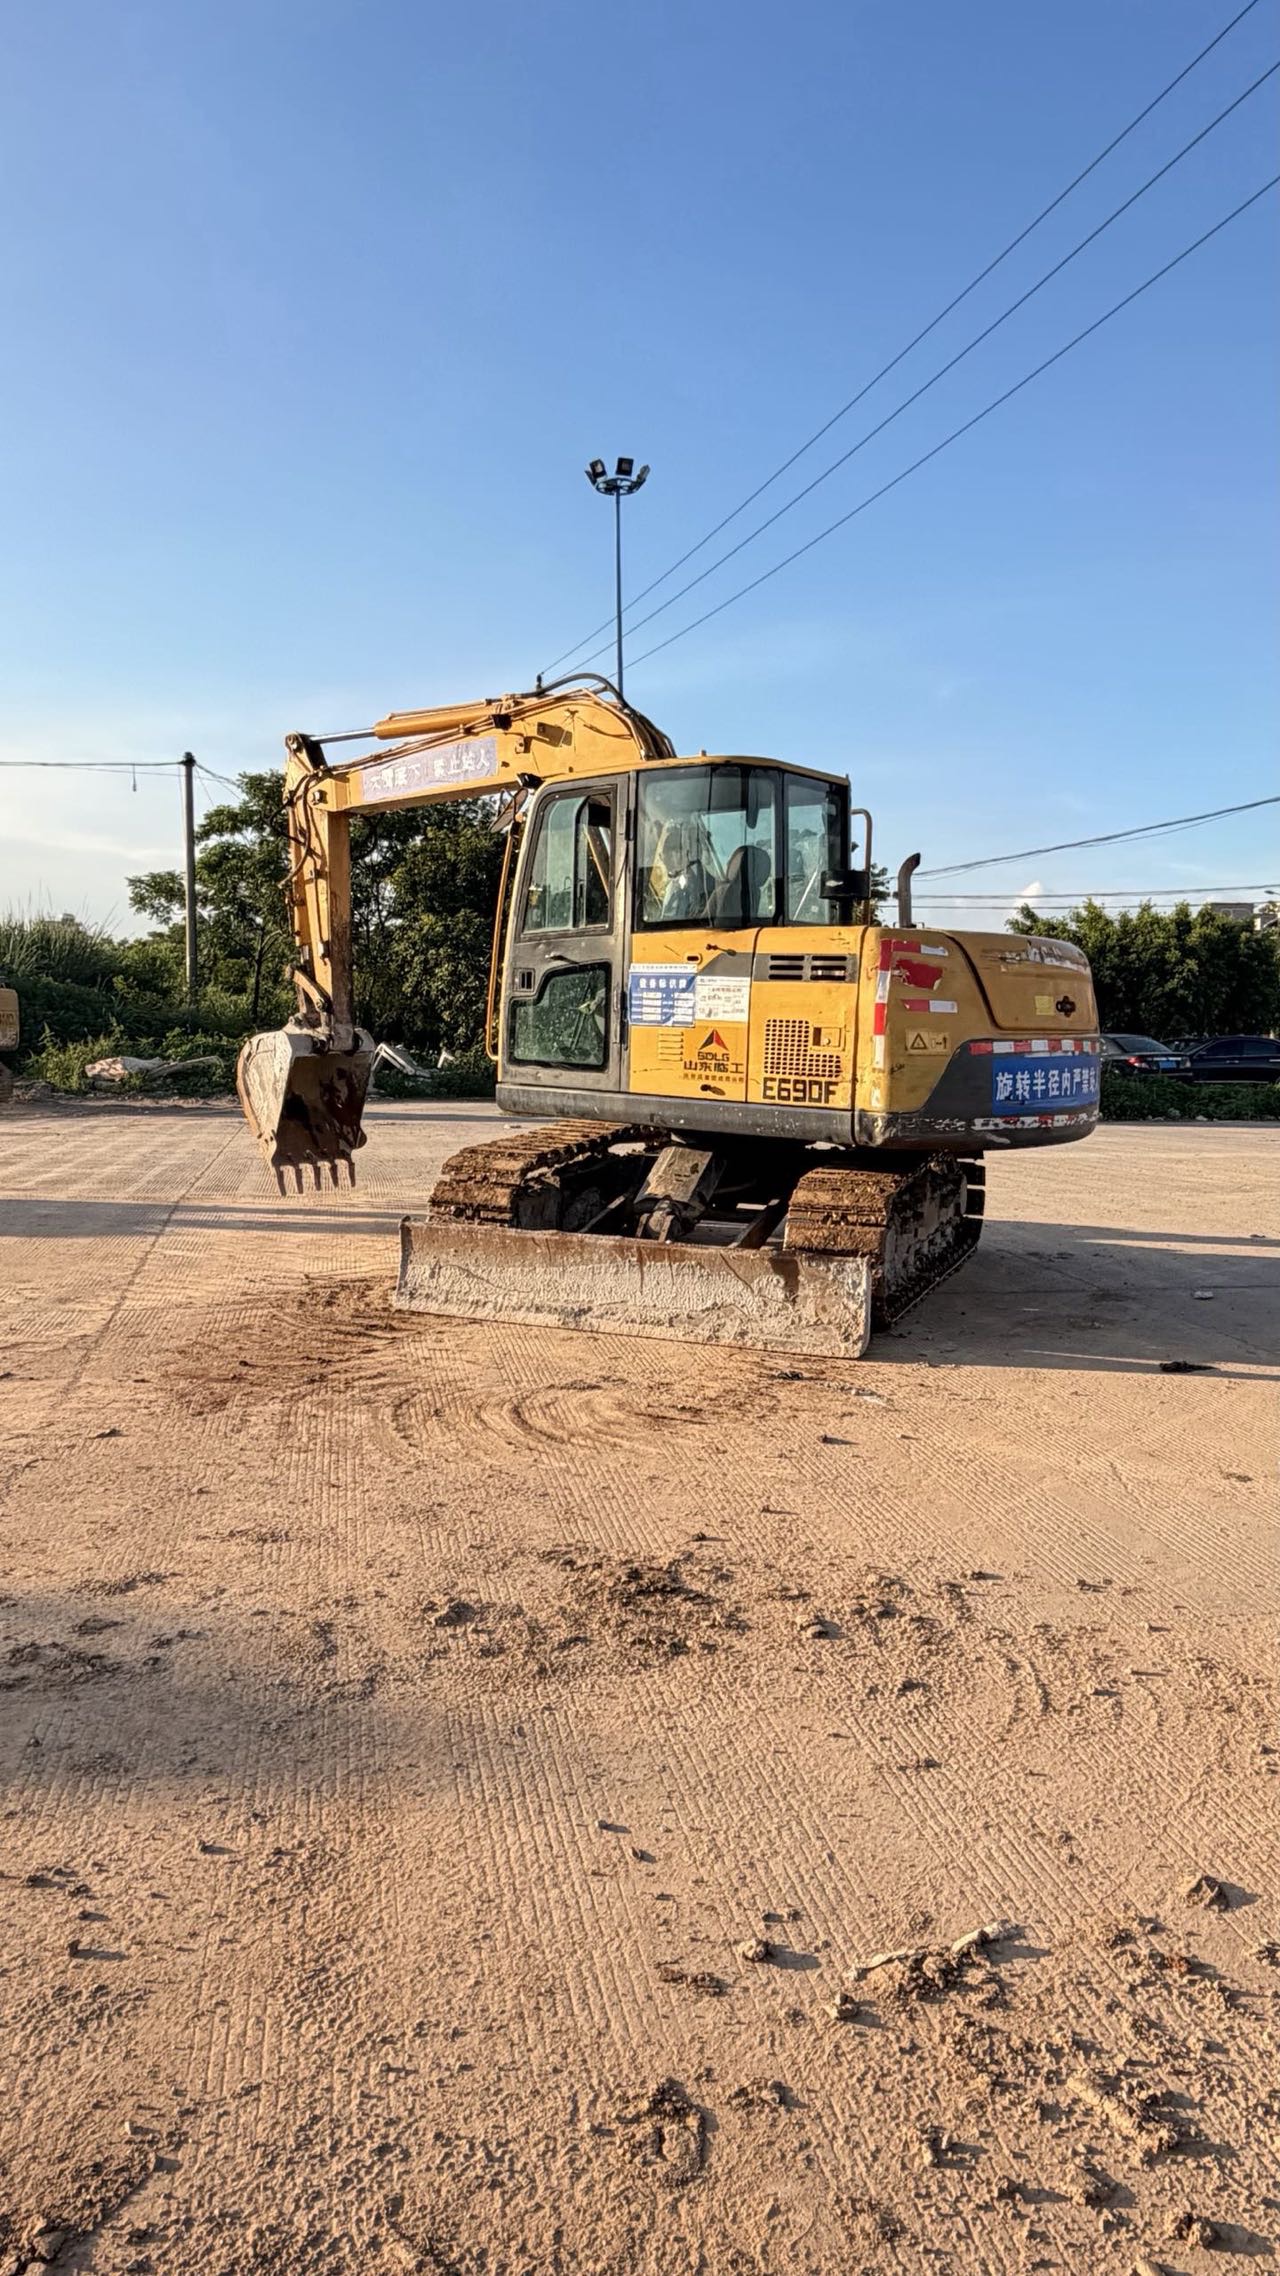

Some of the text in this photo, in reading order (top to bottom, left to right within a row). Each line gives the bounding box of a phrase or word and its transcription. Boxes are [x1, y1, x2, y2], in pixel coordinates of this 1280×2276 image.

[697, 1051, 730, 1062] SDLG
[683, 1060, 744, 1074] 山东临工
[762, 1077, 839, 1104] E690F
